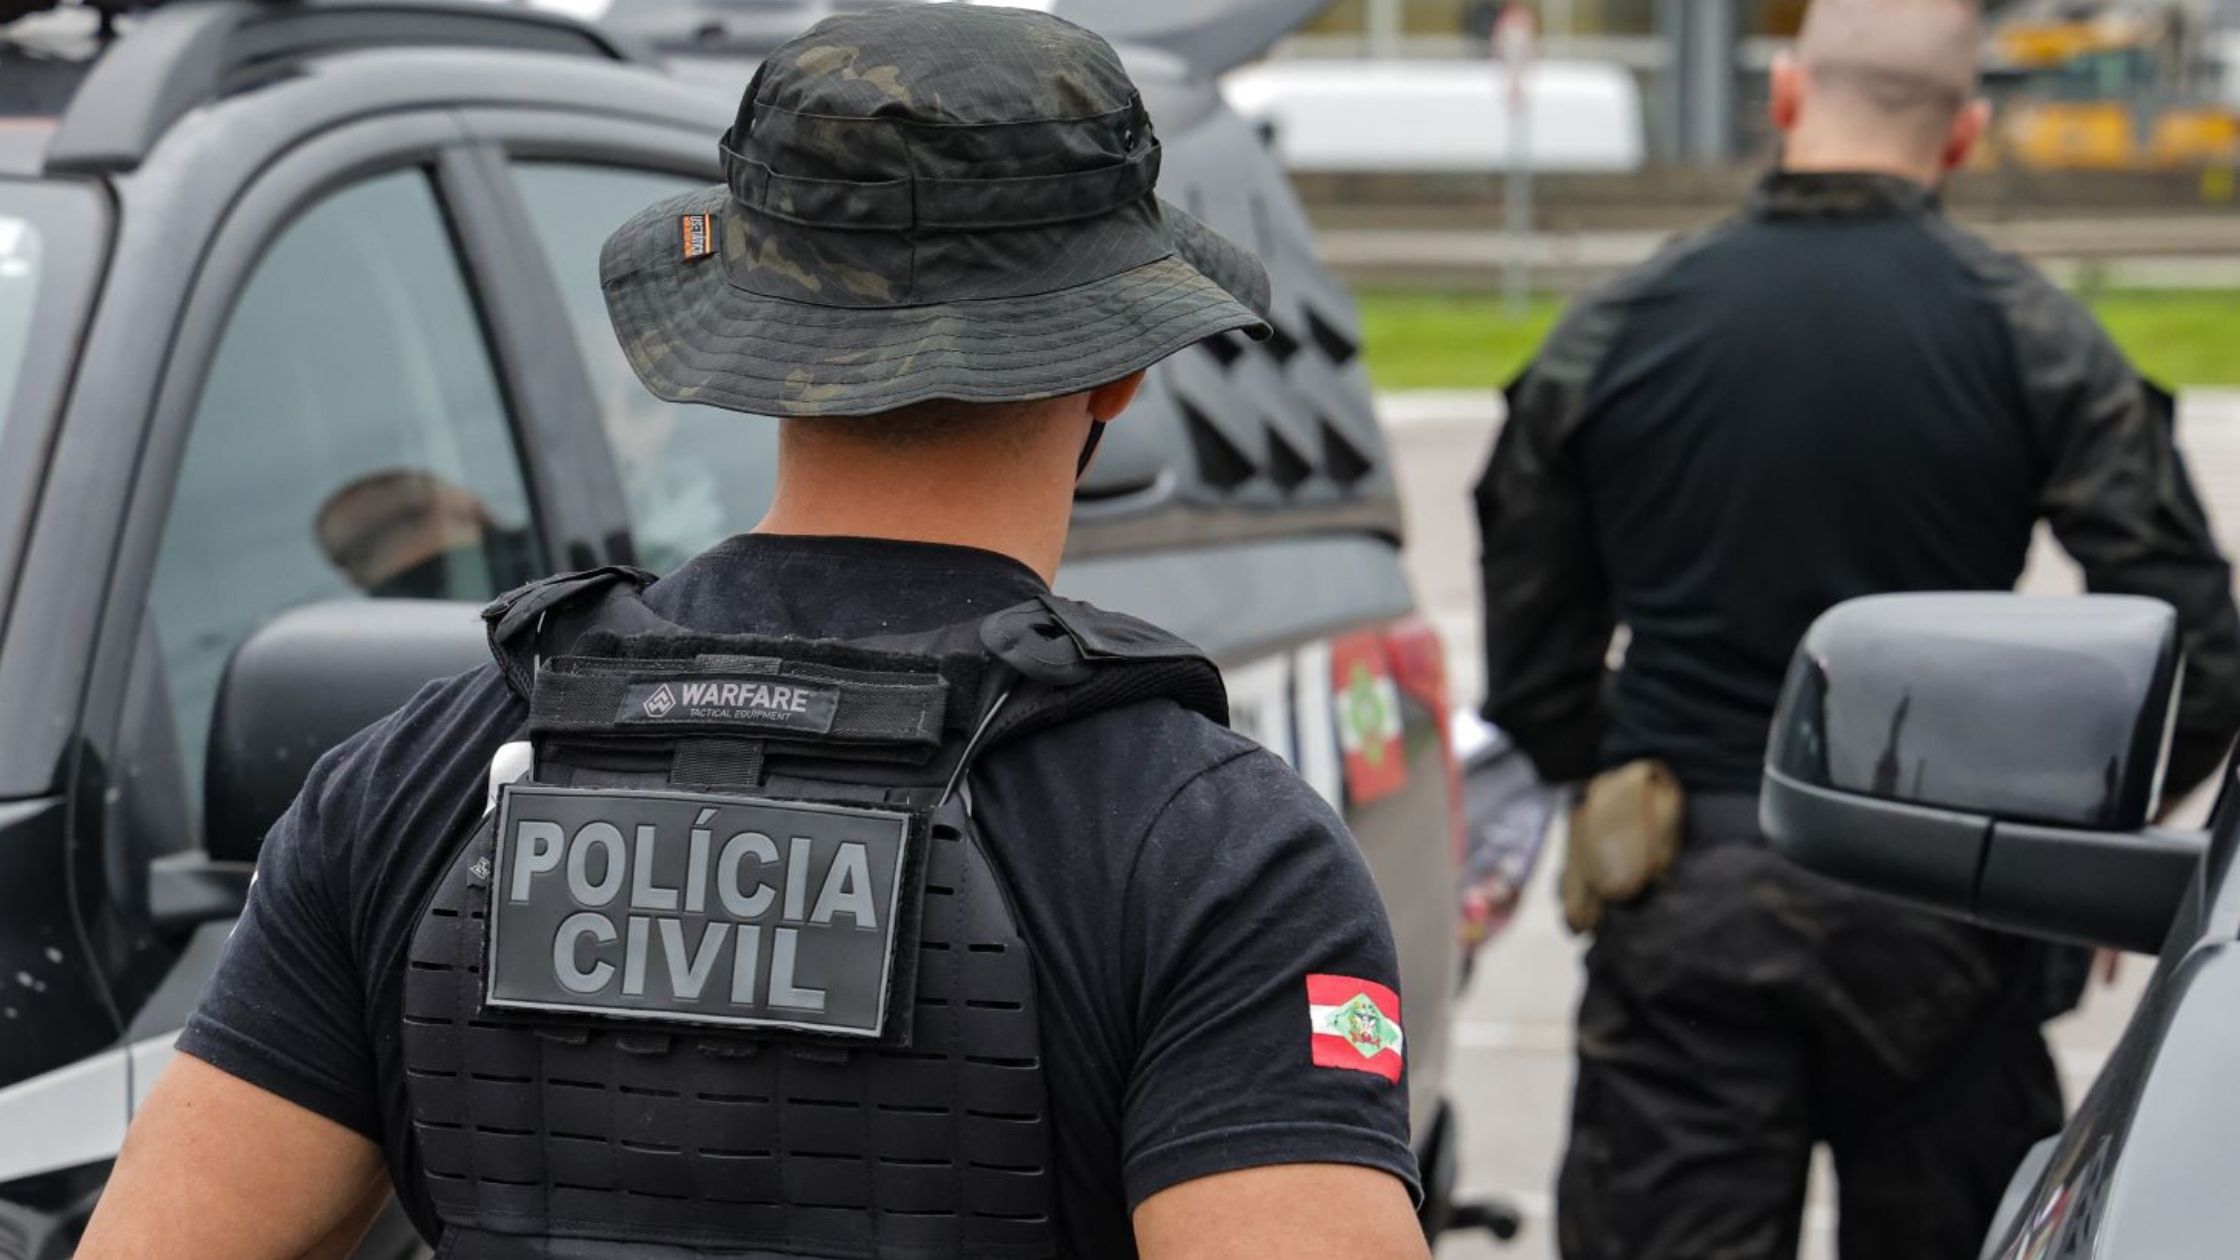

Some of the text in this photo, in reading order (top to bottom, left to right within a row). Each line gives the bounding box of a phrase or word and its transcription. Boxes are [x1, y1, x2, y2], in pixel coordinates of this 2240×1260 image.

[681, 683, 810, 713] WARFARE
[689, 708, 792, 721] TACTICAL EQUIPMENT
[510, 807, 878, 929] POLÍCIA
[552, 911, 827, 1010] CIVIL
